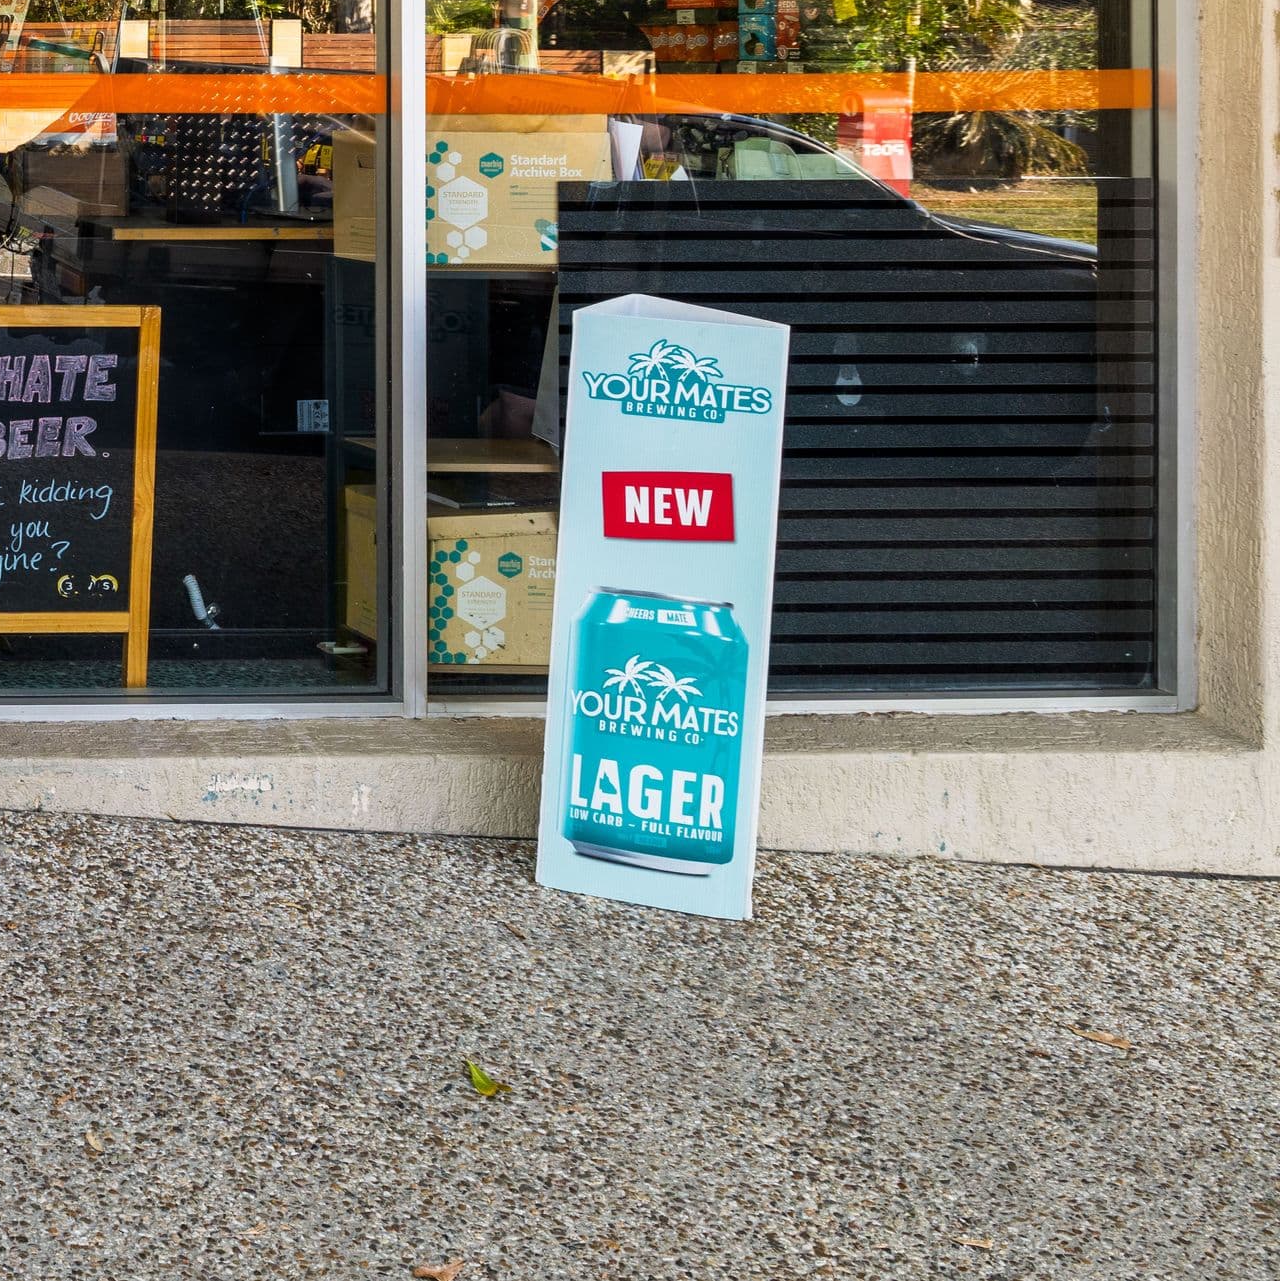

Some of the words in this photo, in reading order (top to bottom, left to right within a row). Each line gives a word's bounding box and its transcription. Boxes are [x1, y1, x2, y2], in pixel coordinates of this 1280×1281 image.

[510, 155, 567, 166] Standard
[510, 167, 556, 177] Archive
[560, 168, 582, 177] Box
[585, 373, 670, 404] YOUR
[675, 382, 771, 413] MATES
[626, 402, 696, 418] BREWING
[19, 478, 114, 520] kidding
[625, 486, 713, 527] NEW
[11, 521, 51, 551] you
[667, 613, 688, 623] MATE
[571, 689, 647, 725] YOUR
[653, 699, 739, 737] MATES
[599, 720, 677, 741] BREWING
[570, 754, 725, 829] LAGER
[570, 807, 589, 820] LOW
[593, 812, 622, 827] CARB
[641, 820, 671, 836] FULL
[677, 827, 723, 842] FLAVOUR
